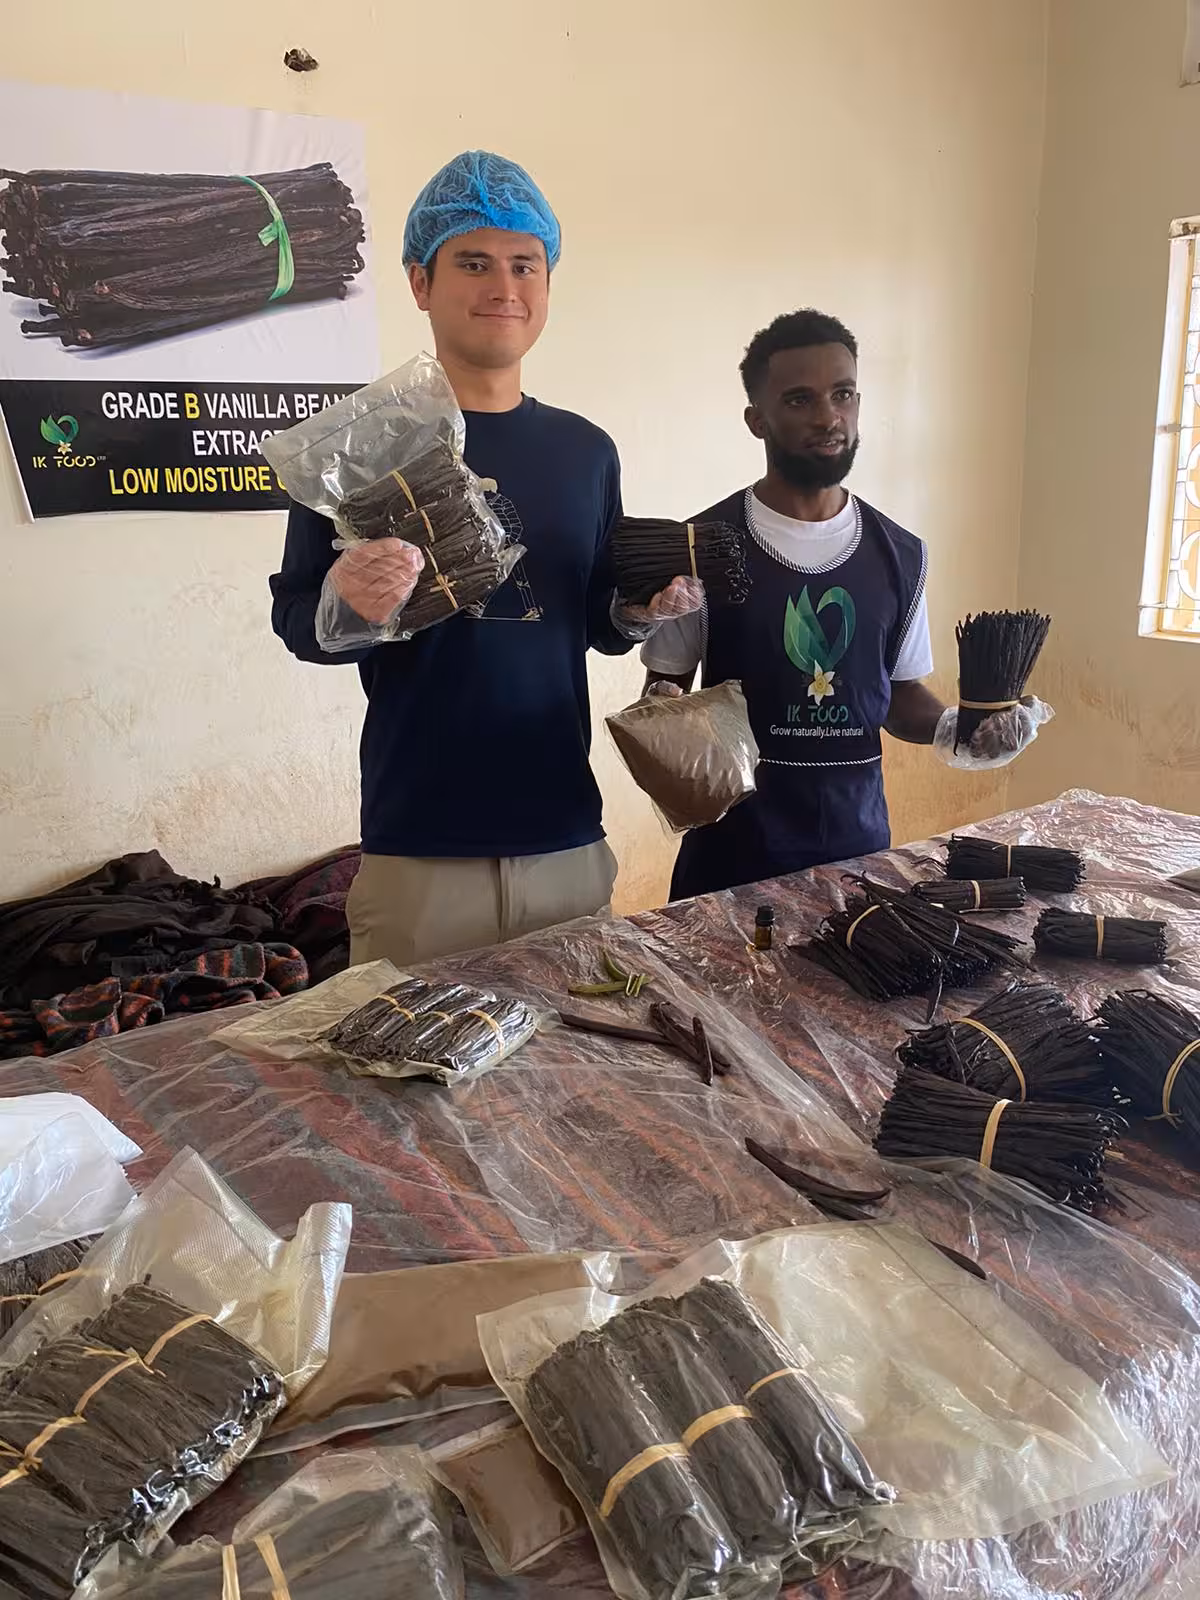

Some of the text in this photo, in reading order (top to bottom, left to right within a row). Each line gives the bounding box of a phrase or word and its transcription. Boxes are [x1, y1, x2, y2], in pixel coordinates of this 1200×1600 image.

[101, 391, 180, 419] GRADE
[184, 392, 200, 419] B
[203, 392, 291, 419] VANILLA
[192, 429, 285, 456] EXTRA
[32, 456, 48, 468] IK
[53, 455, 96, 468] FOOD
[109, 467, 159, 495] LOW
[164, 466, 272, 493] MOISTURE
[787, 704, 849, 722] IK FOOD
[769, 724, 791, 736] Grow
[841, 726, 864, 737] natural
